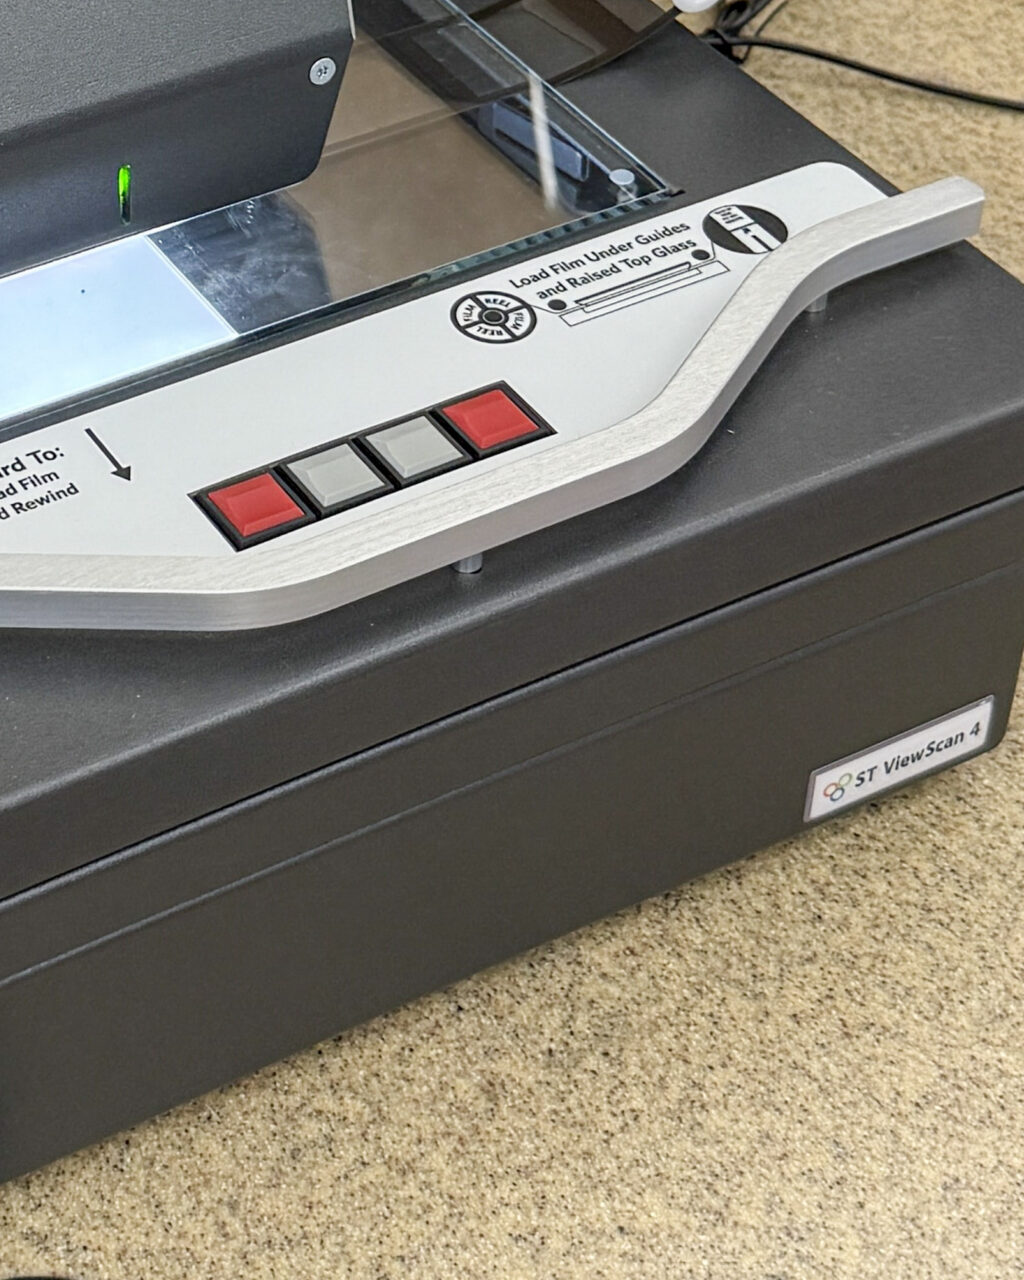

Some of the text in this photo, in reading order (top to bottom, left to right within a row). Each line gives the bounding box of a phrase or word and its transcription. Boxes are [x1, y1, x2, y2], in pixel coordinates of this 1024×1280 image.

[509, 221, 691, 290] Load Film Under Guides
[536, 238, 697, 300] and Raised Top Glass
[462, 304, 476, 322] FILM
[484, 298, 511, 308] REEL
[26, 445, 65, 467] To:
[22, 469, 60, 491] Film
[14, 483, 80, 514] Rewind
[855, 721, 981, 787] ST ViewScan 4
